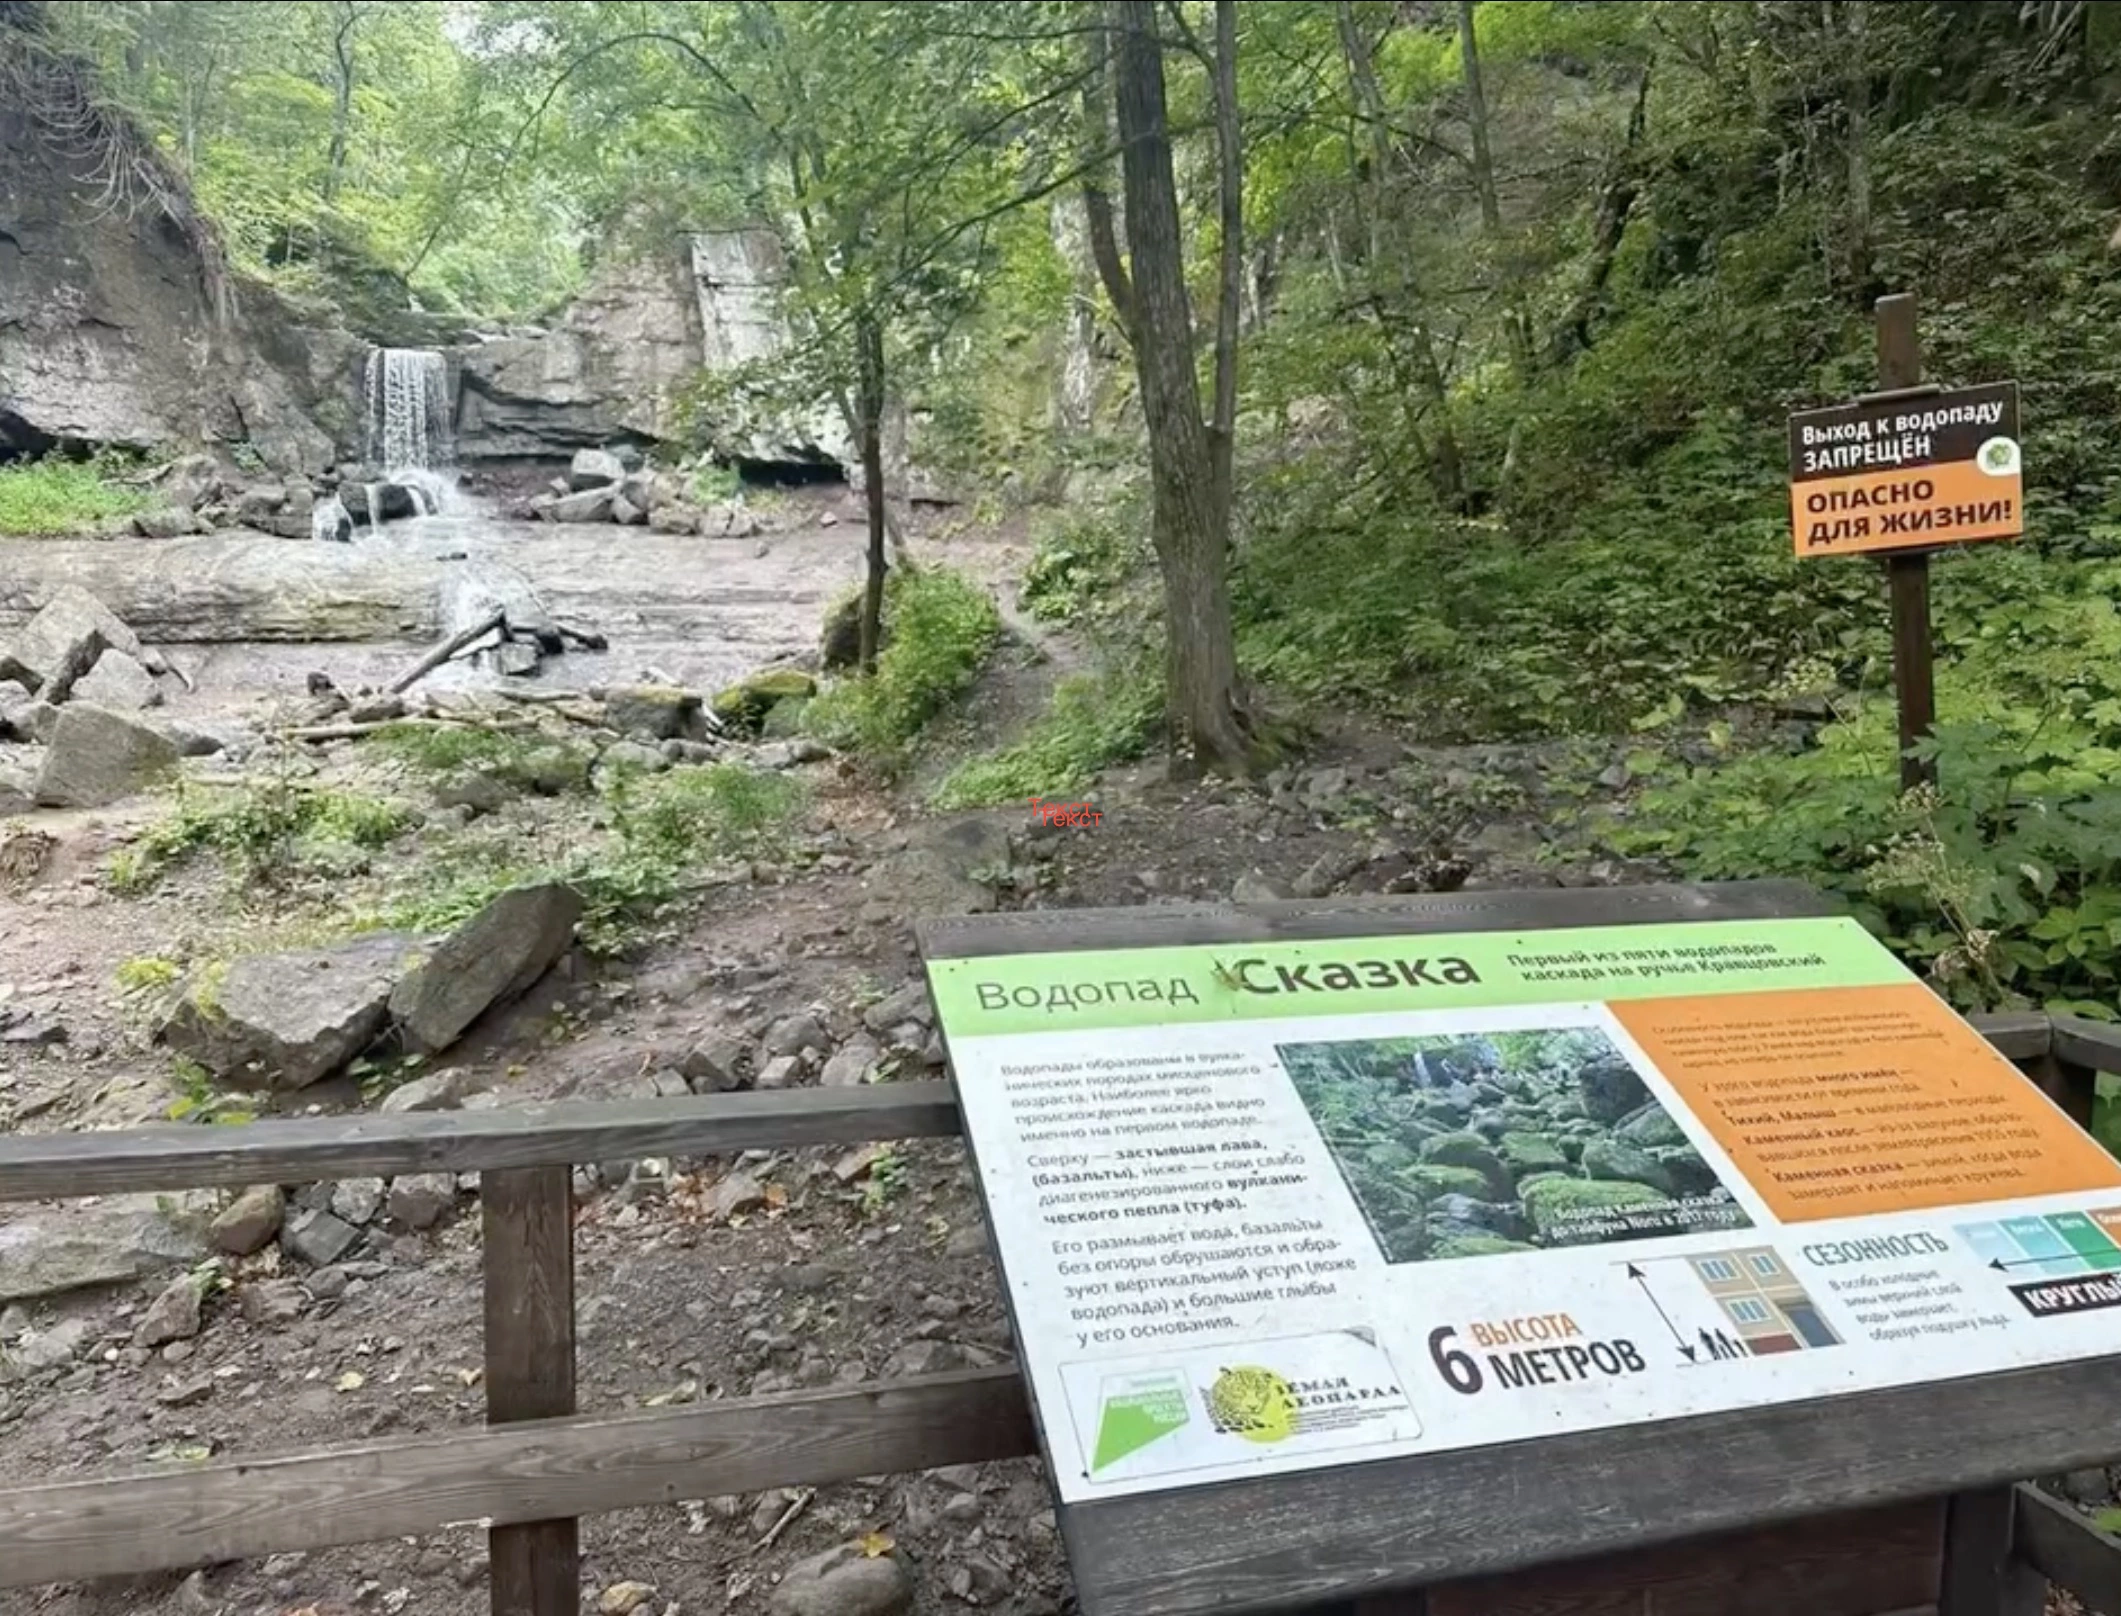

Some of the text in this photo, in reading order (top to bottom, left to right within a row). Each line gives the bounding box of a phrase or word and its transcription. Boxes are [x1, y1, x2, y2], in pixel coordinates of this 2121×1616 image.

[1802, 400, 2004, 446] Выход к водопаду
[1803, 433, 1932, 473] ЗАПРЕЩЁН
[1807, 479, 1935, 514] ОПАСНО
[1808, 499, 2012, 547] ДЛЯ ЖИЗНИ!
[1507, 950, 1590, 968] Первый
[1593, 951, 1619, 963] из
[1621, 949, 1671, 960] пяти
[1521, 967, 1607, 981] каскада
[1608, 965, 1634, 976] на
[976, 956, 1481, 1013] Водопад Сказка
[1151, 1102, 1213, 1115] каскада
[1020, 1127, 1087, 1142] именно
[1091, 1126, 1111, 1137] на
[1115, 1120, 1178, 1136] первом
[1027, 1152, 1090, 1169] Сверху
[1114, 1142, 1217, 1160] застывшая
[1220, 1138, 1268, 1152] лава,
[1141, 1161, 1187, 1177] ниже
[1213, 1157, 1254, 1171] слои
[1256, 1151, 1305, 1168] слабо
[1043, 1207, 1120, 1225] ческого
[1123, 1201, 1180, 1217] пепла
[1051, 1218, 1323, 1255] Его размывает вода, базальты
[1802, 1230, 1949, 1267] СЕЗОННОСТЬ
[1058, 1235, 1342, 1275] без опоры обрушаются и обра-
[1063, 1258, 1357, 1299] зуют вертикальный уступ (ложе
[1071, 1281, 1337, 1320] водопада) и большие глыбы
[1076, 1315, 1240, 1348] у его основания.
[1470, 1312, 1583, 1347] ВЫСОТА
[1428, 1325, 1646, 1395] 6 МЕТРОВ
